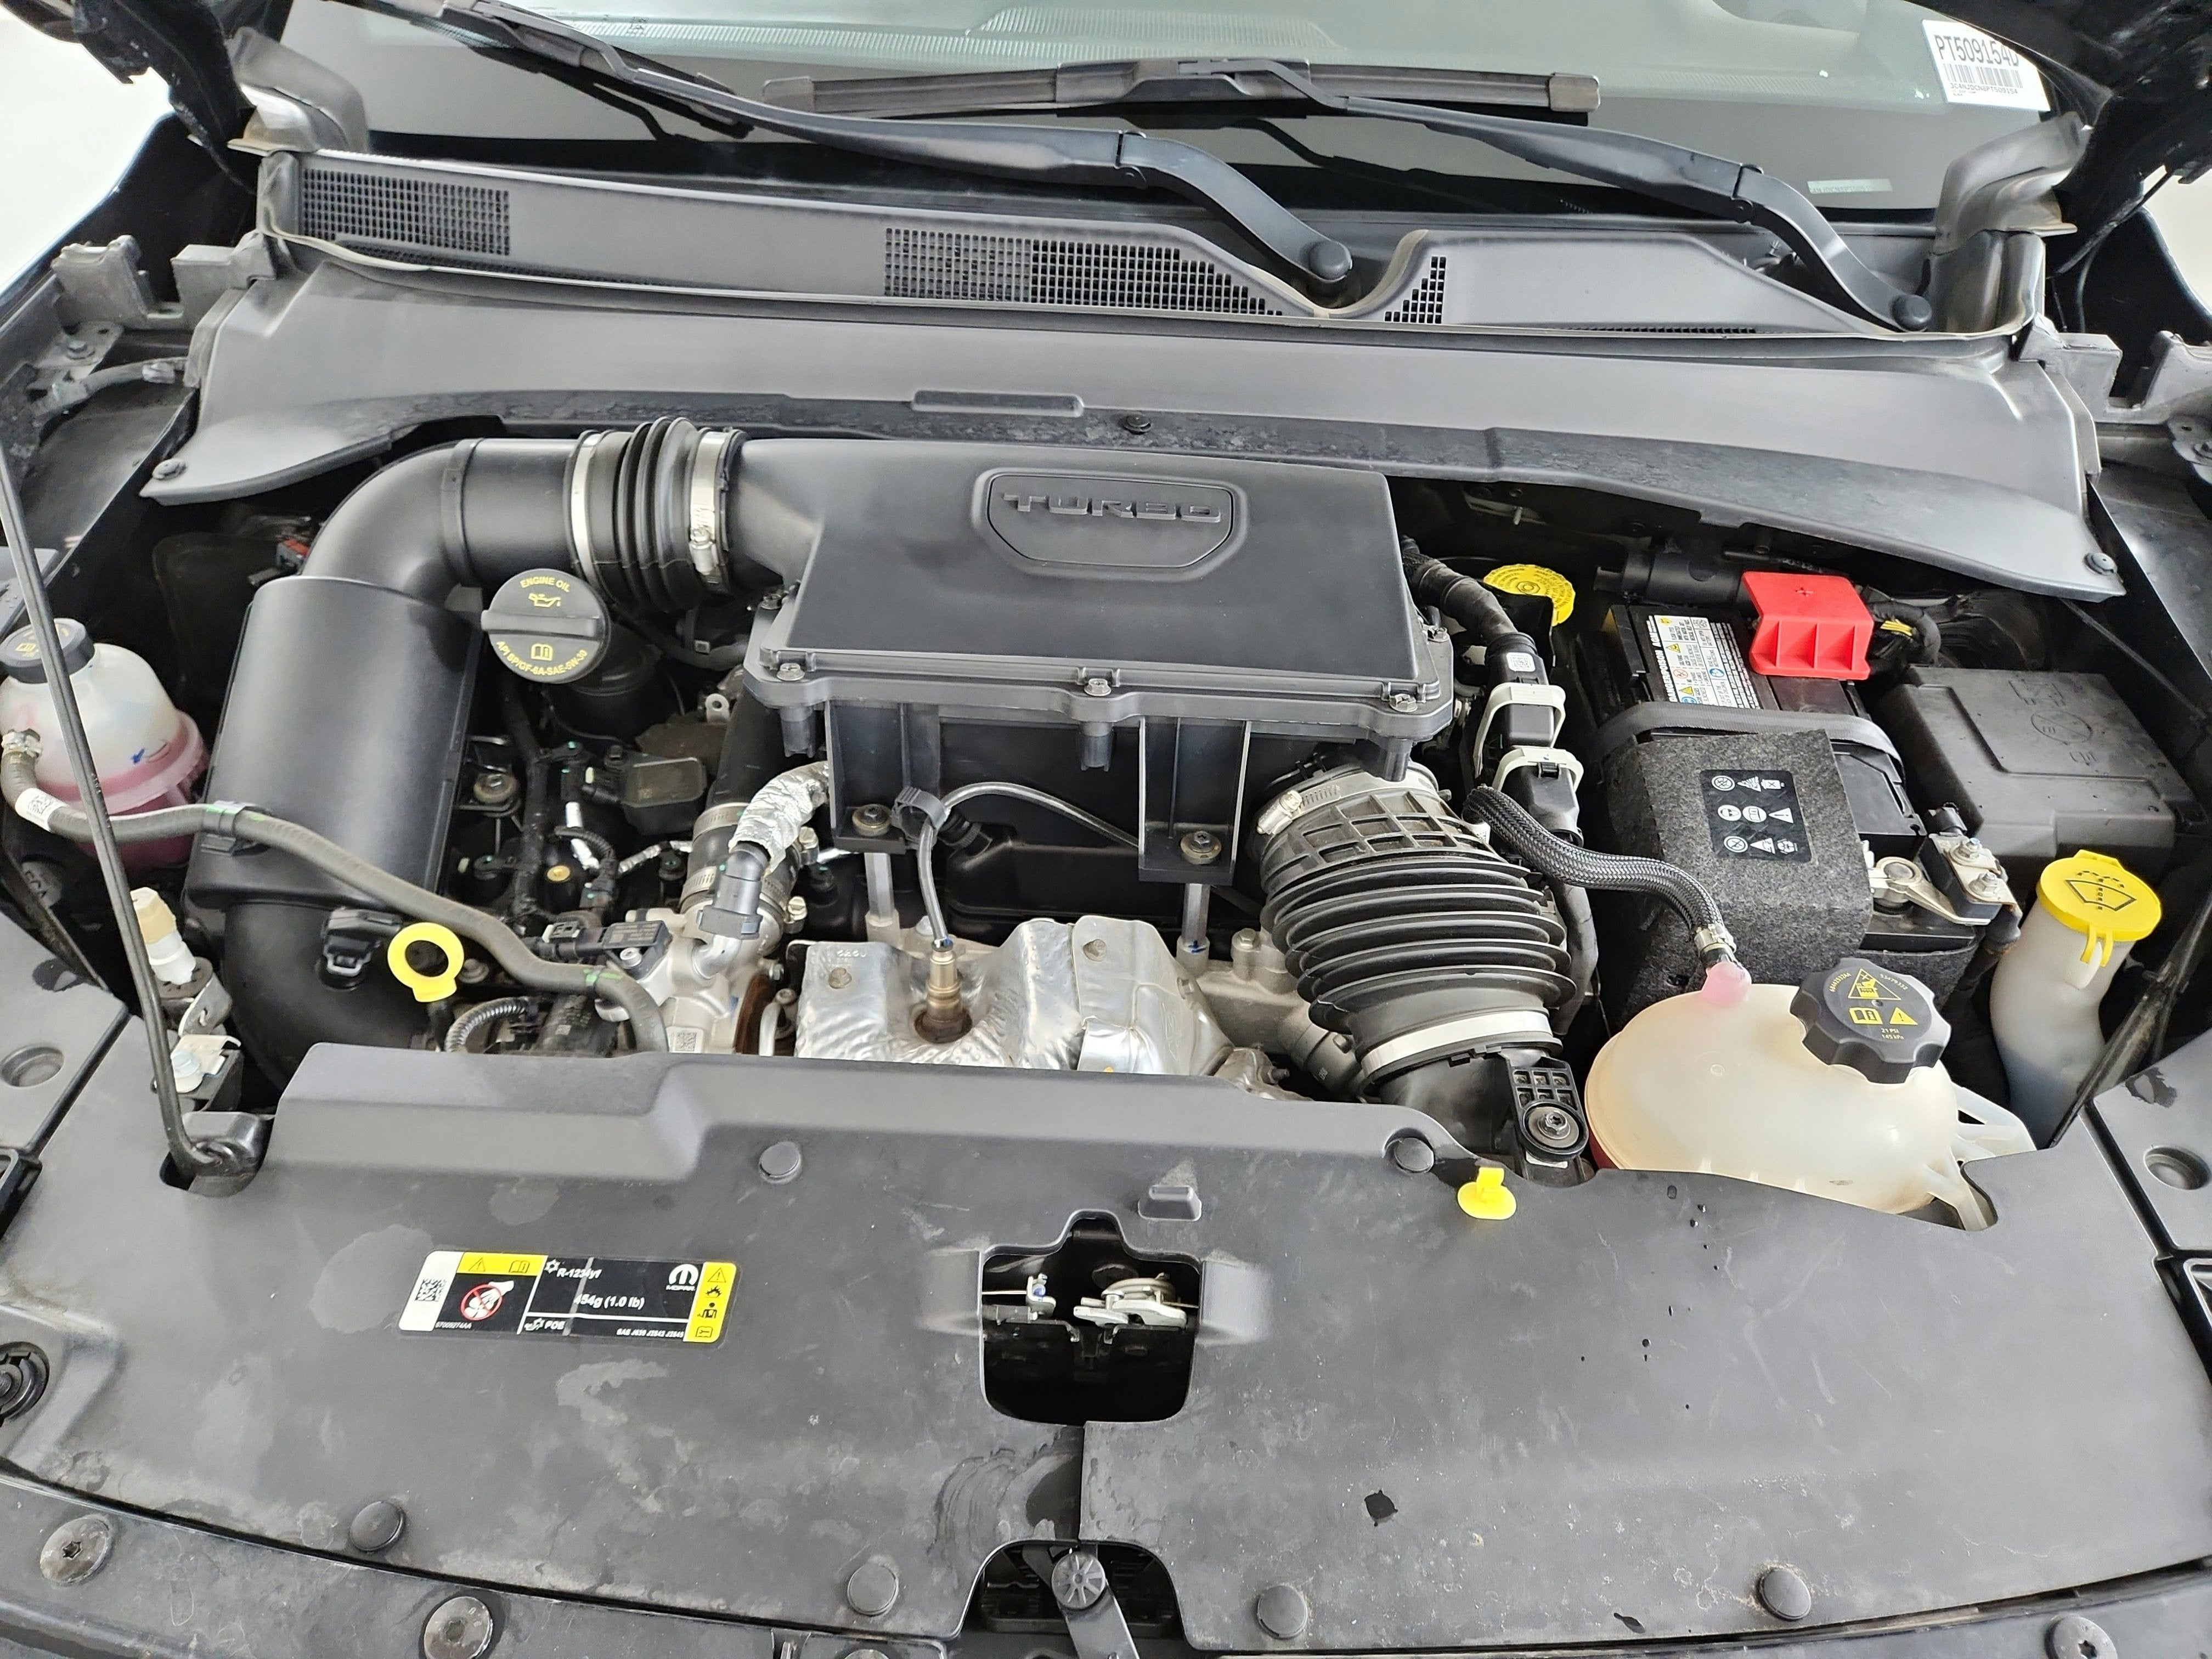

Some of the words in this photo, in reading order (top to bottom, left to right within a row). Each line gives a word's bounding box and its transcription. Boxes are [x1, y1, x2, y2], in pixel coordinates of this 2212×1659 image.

[1003, 492, 1221, 523] TURBO
[520, 576, 555, 589] ENGINE
[556, 580, 571, 592] OIL
[574, 1294, 603, 1309] 454g
[604, 1295, 628, 1309] (1.0
[628, 1296, 645, 1310] lb)
